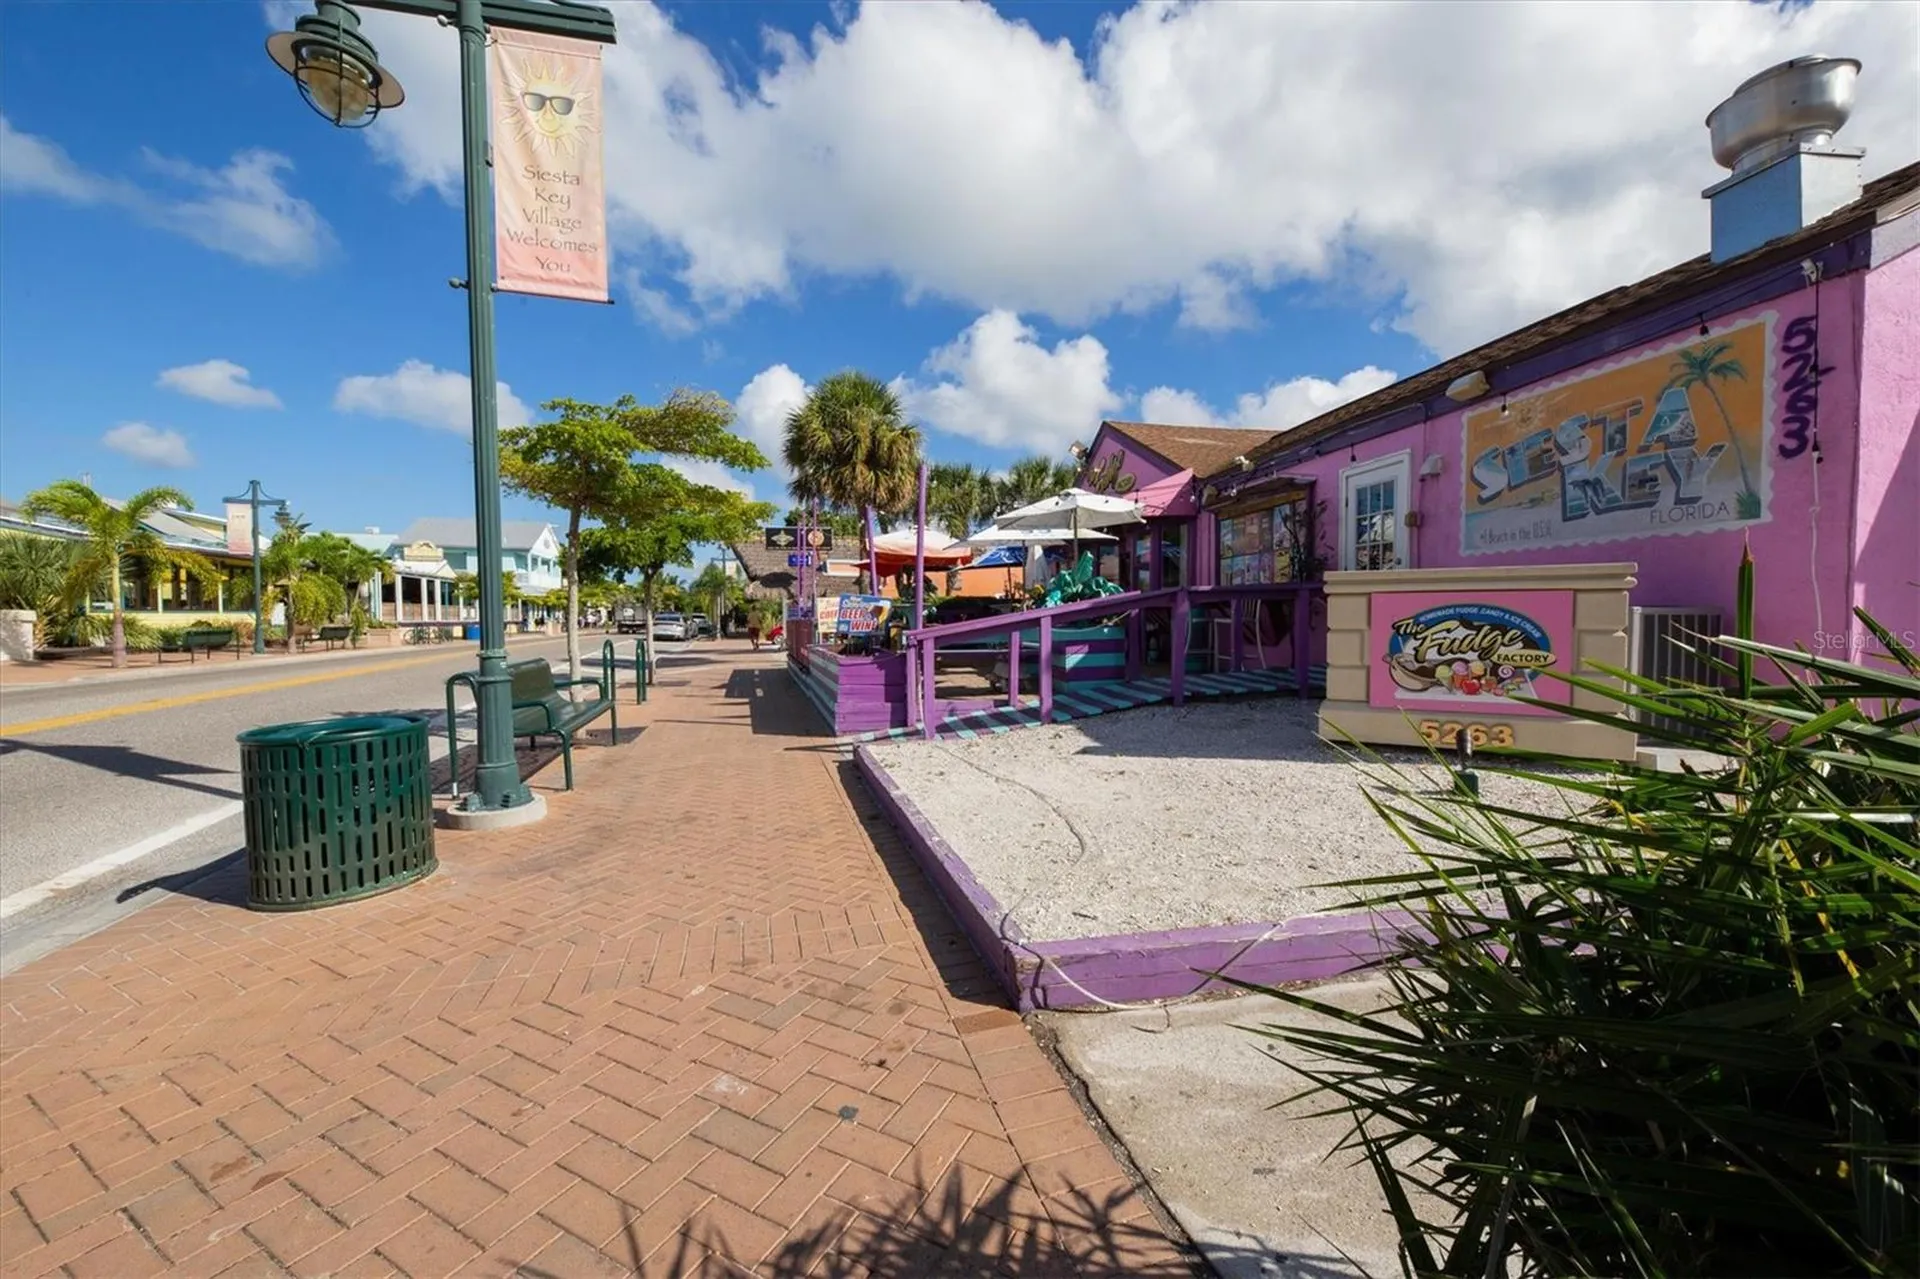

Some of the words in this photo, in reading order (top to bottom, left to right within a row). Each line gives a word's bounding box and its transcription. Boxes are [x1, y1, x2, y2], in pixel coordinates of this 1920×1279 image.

[522, 165, 581, 186] Siesta
[535, 188, 571, 212] Key
[523, 206, 582, 234] Village
[506, 228, 598, 252] Welcomes
[536, 256, 571, 273] You
[1778, 315, 1821, 459] 5263
[1471, 387, 1699, 505] SIESTA
[1561, 442, 1728, 522] KEY
[1650, 501, 1730, 524] FLORIDA
[840, 607, 865, 620] BEER
[1418, 607, 1455, 621] HOMEMADE
[1520, 619, 1542, 638] CREAM
[1393, 619, 1426, 636] The
[1414, 620, 1526, 663] Fudge
[1496, 652, 1549, 663] FACTORY
[1419, 720, 1515, 747] 5263
